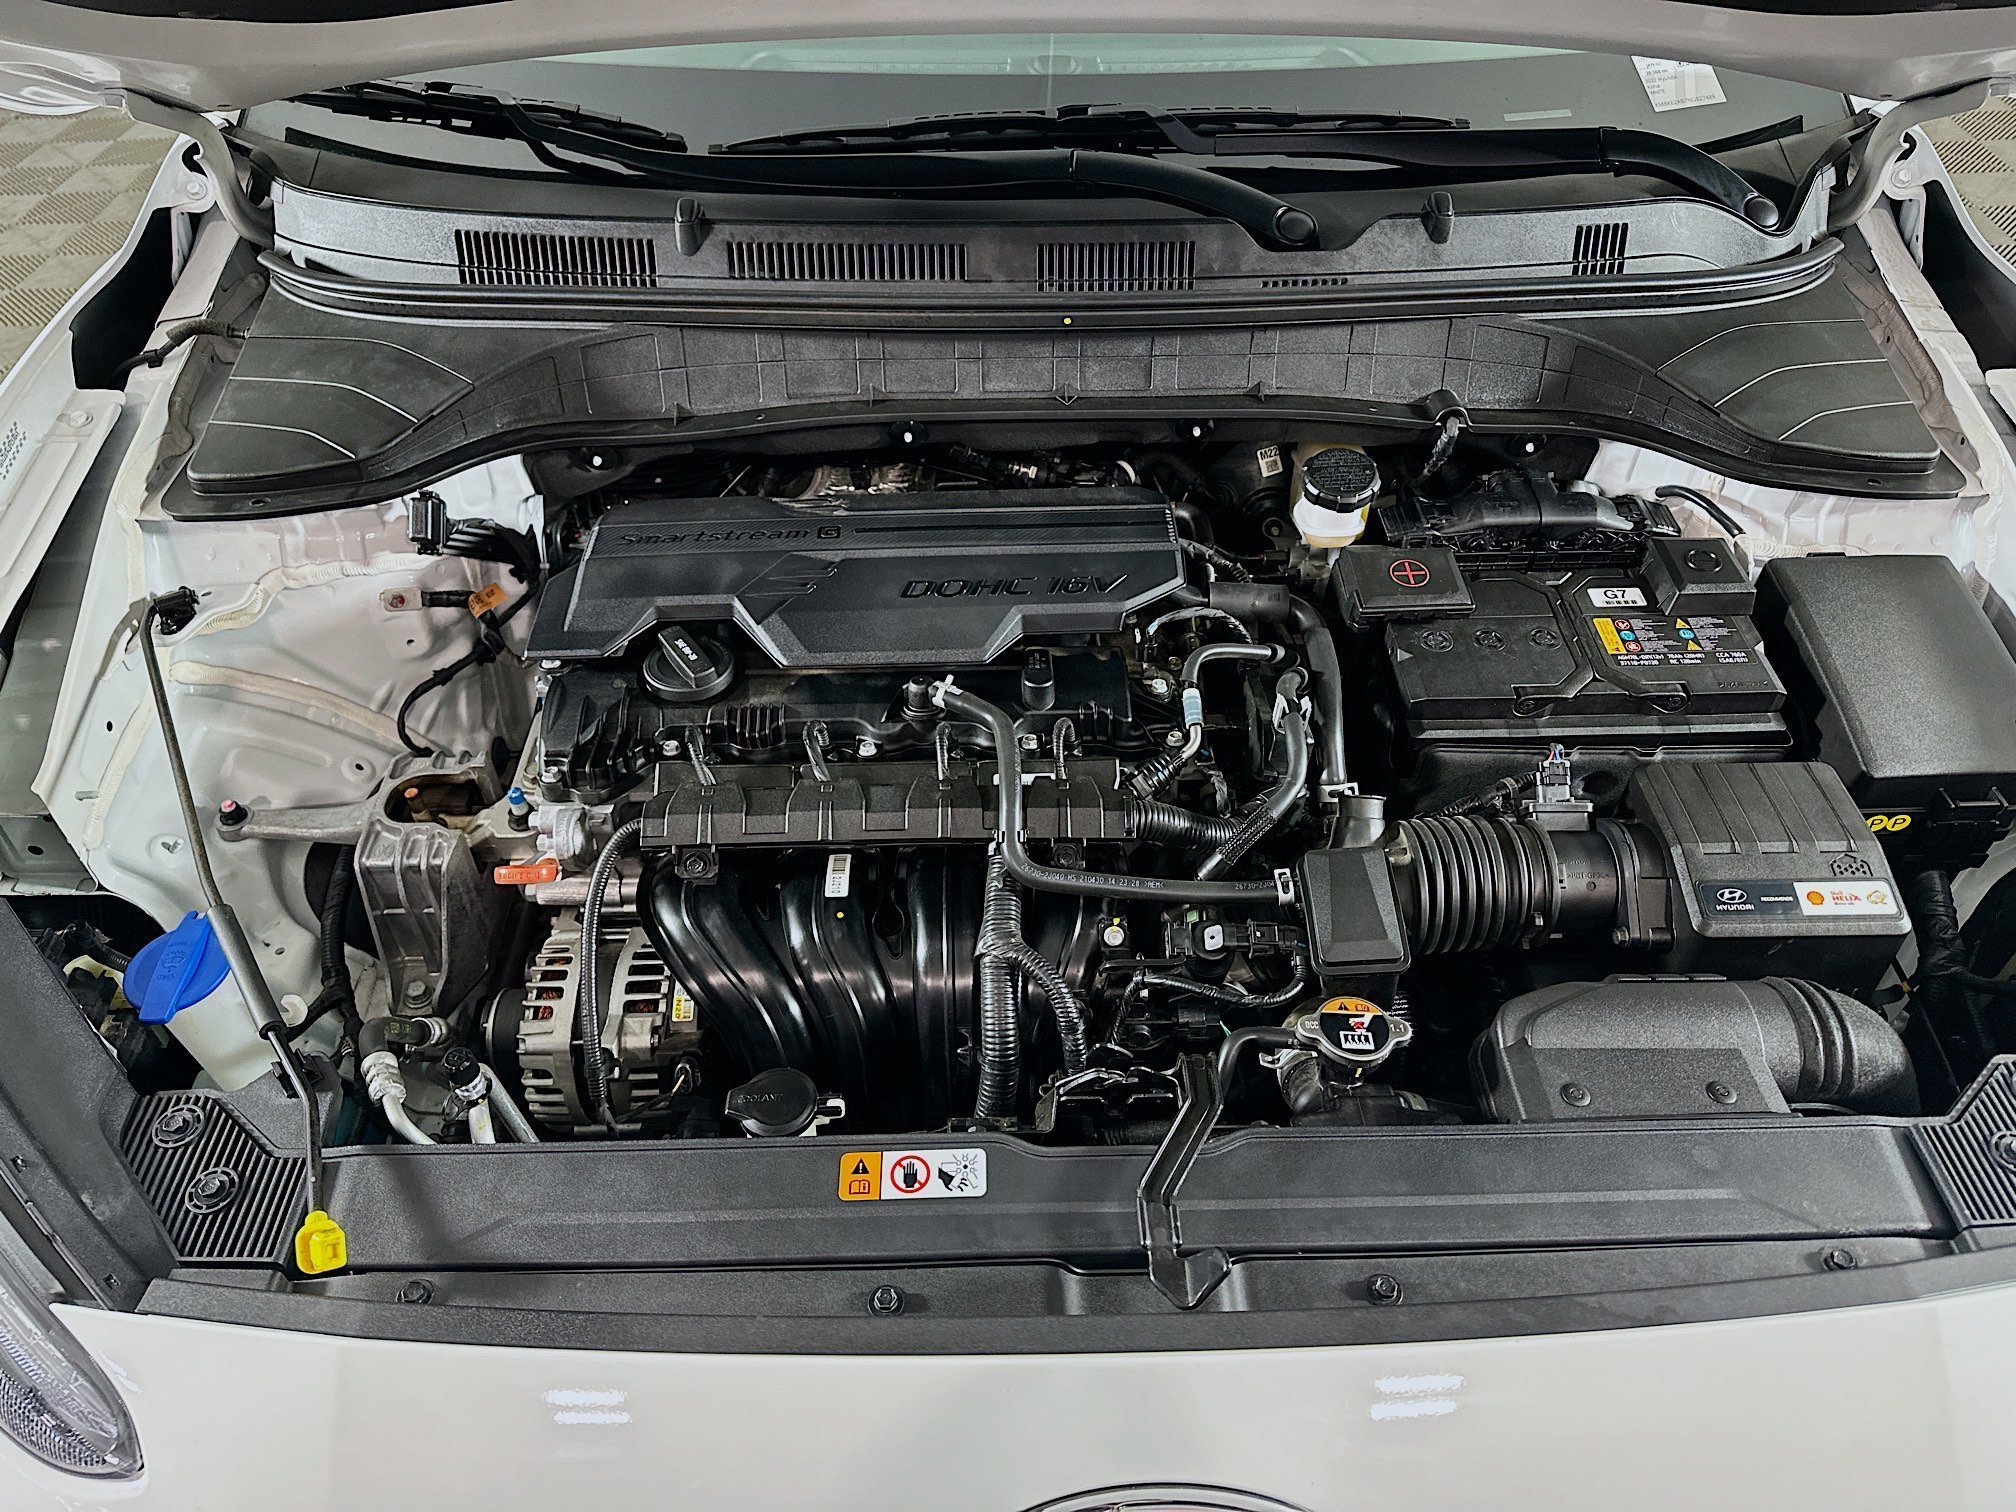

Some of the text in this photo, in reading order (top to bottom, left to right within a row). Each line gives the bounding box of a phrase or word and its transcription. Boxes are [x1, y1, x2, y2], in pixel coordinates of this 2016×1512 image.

[1259, 446, 1280, 461] M22
[616, 528, 811, 545] Smartstream
[900, 574, 1128, 599] DOHC 16V
[1603, 588, 1628, 600] G7
[1021, 863, 1065, 880] 26730-2J040
[1079, 875, 1104, 884] 210430
[1108, 877, 1116, 885] 14
[1119, 879, 1128, 887] 23
[1131, 879, 1140, 887] 28
[1235, 880, 1277, 890] 26730-2J04
[1832, 894, 1861, 902] HELIX
[1715, 903, 1755, 911] HYUNDAI
